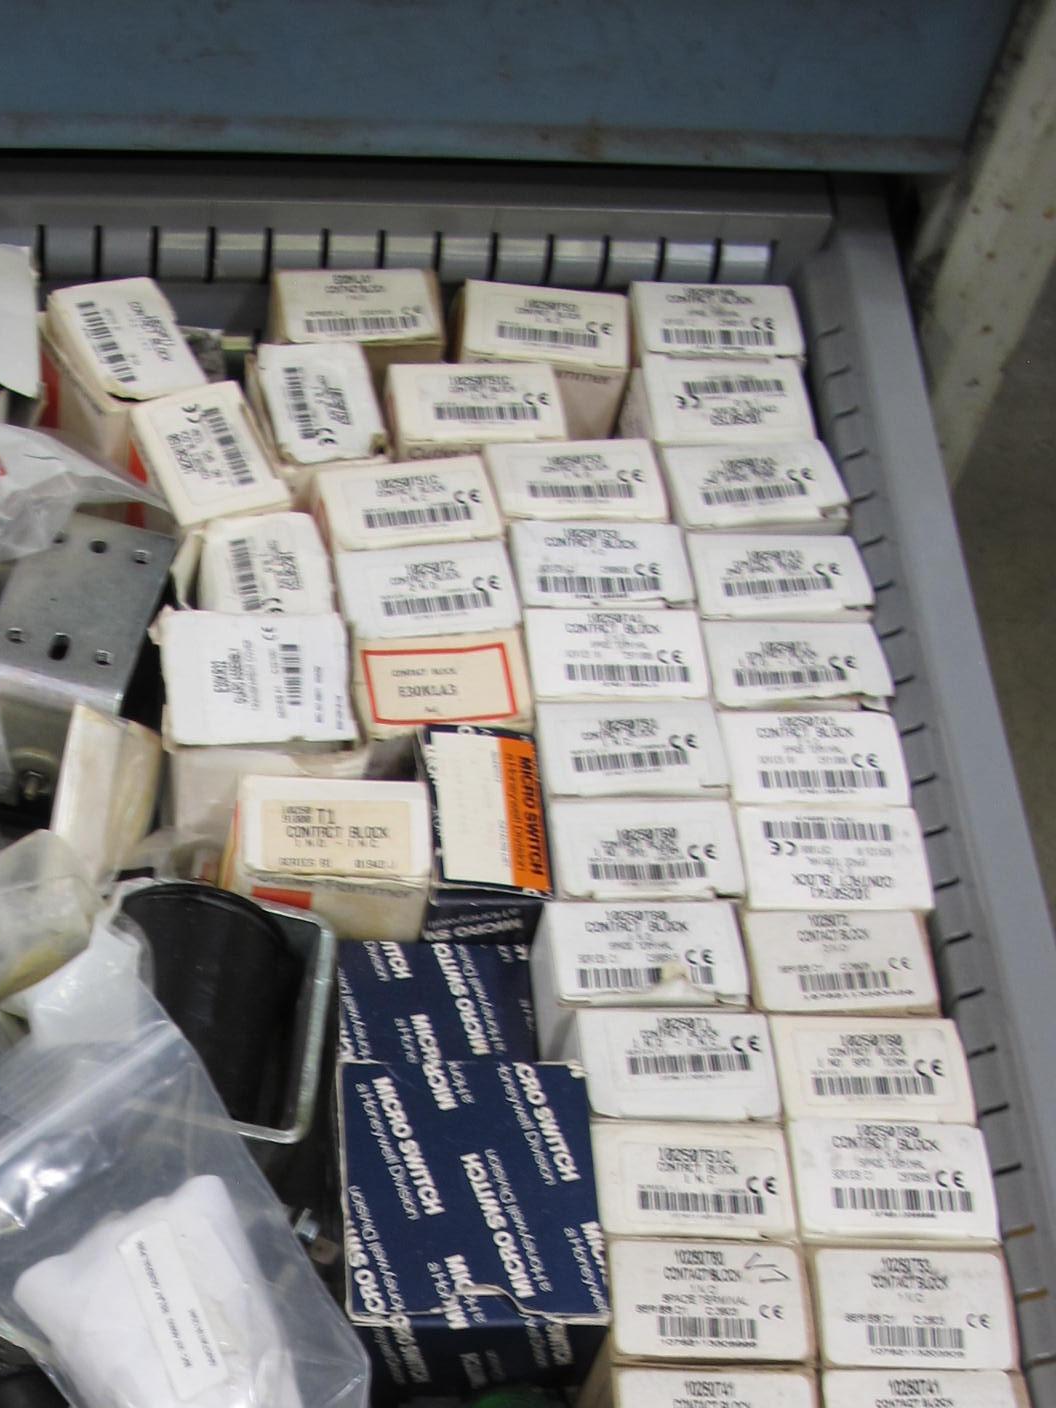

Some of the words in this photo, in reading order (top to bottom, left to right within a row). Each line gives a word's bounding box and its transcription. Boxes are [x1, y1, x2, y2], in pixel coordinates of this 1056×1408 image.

[519, 757, 539, 808] MICRO
[287, 826, 343, 838] CONTACT
[349, 827, 390, 839] BLOCK
[525, 811, 544, 875] SWITCH
[359, 1094, 398, 1165] Honeywell
[388, 1165, 420, 1221] Division
[372, 1076, 412, 1138] MICRO
[398, 1139, 445, 1216] SWITCH
[524, 1132, 558, 1186] Division
[532, 1106, 581, 1183] SWITCH
[460, 1152, 507, 1231] SWITCH
[484, 1149, 516, 1204] Division
[492, 1230, 536, 1299] MICRO
[507, 1204, 548, 1283] Honeywell
[663, 1267, 705, 1281] CONTACT
[708, 1268, 743, 1283] BLOCK
[870, 1275, 912, 1289] CONTACT
[915, 1276, 949, 1291] BLOCK
[875, 1398, 919, 1408] CONTACT
[922, 1398, 955, 1408] BLOCK
